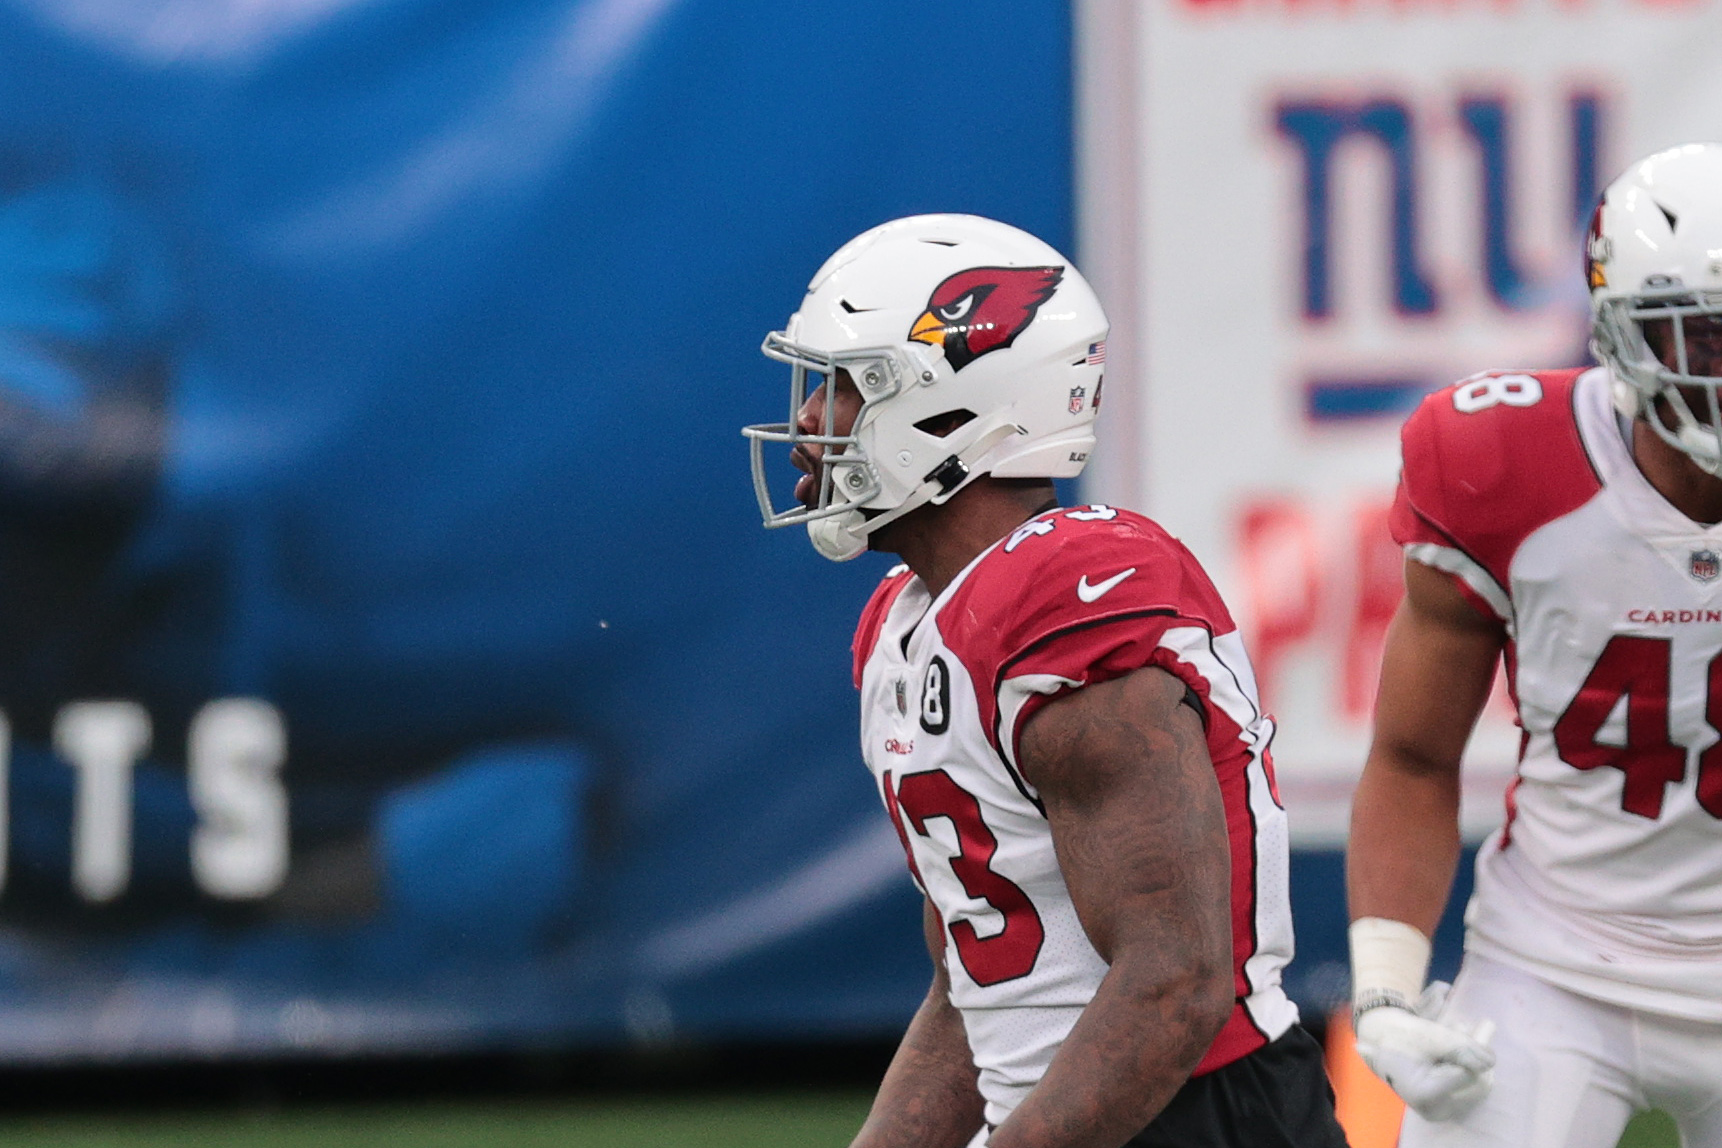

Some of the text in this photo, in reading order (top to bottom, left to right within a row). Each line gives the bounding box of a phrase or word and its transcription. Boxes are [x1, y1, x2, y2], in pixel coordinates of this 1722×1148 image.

[923, 664, 944, 726] 8
[0, 697, 291, 901] TS
[883, 769, 1046, 987] 3
